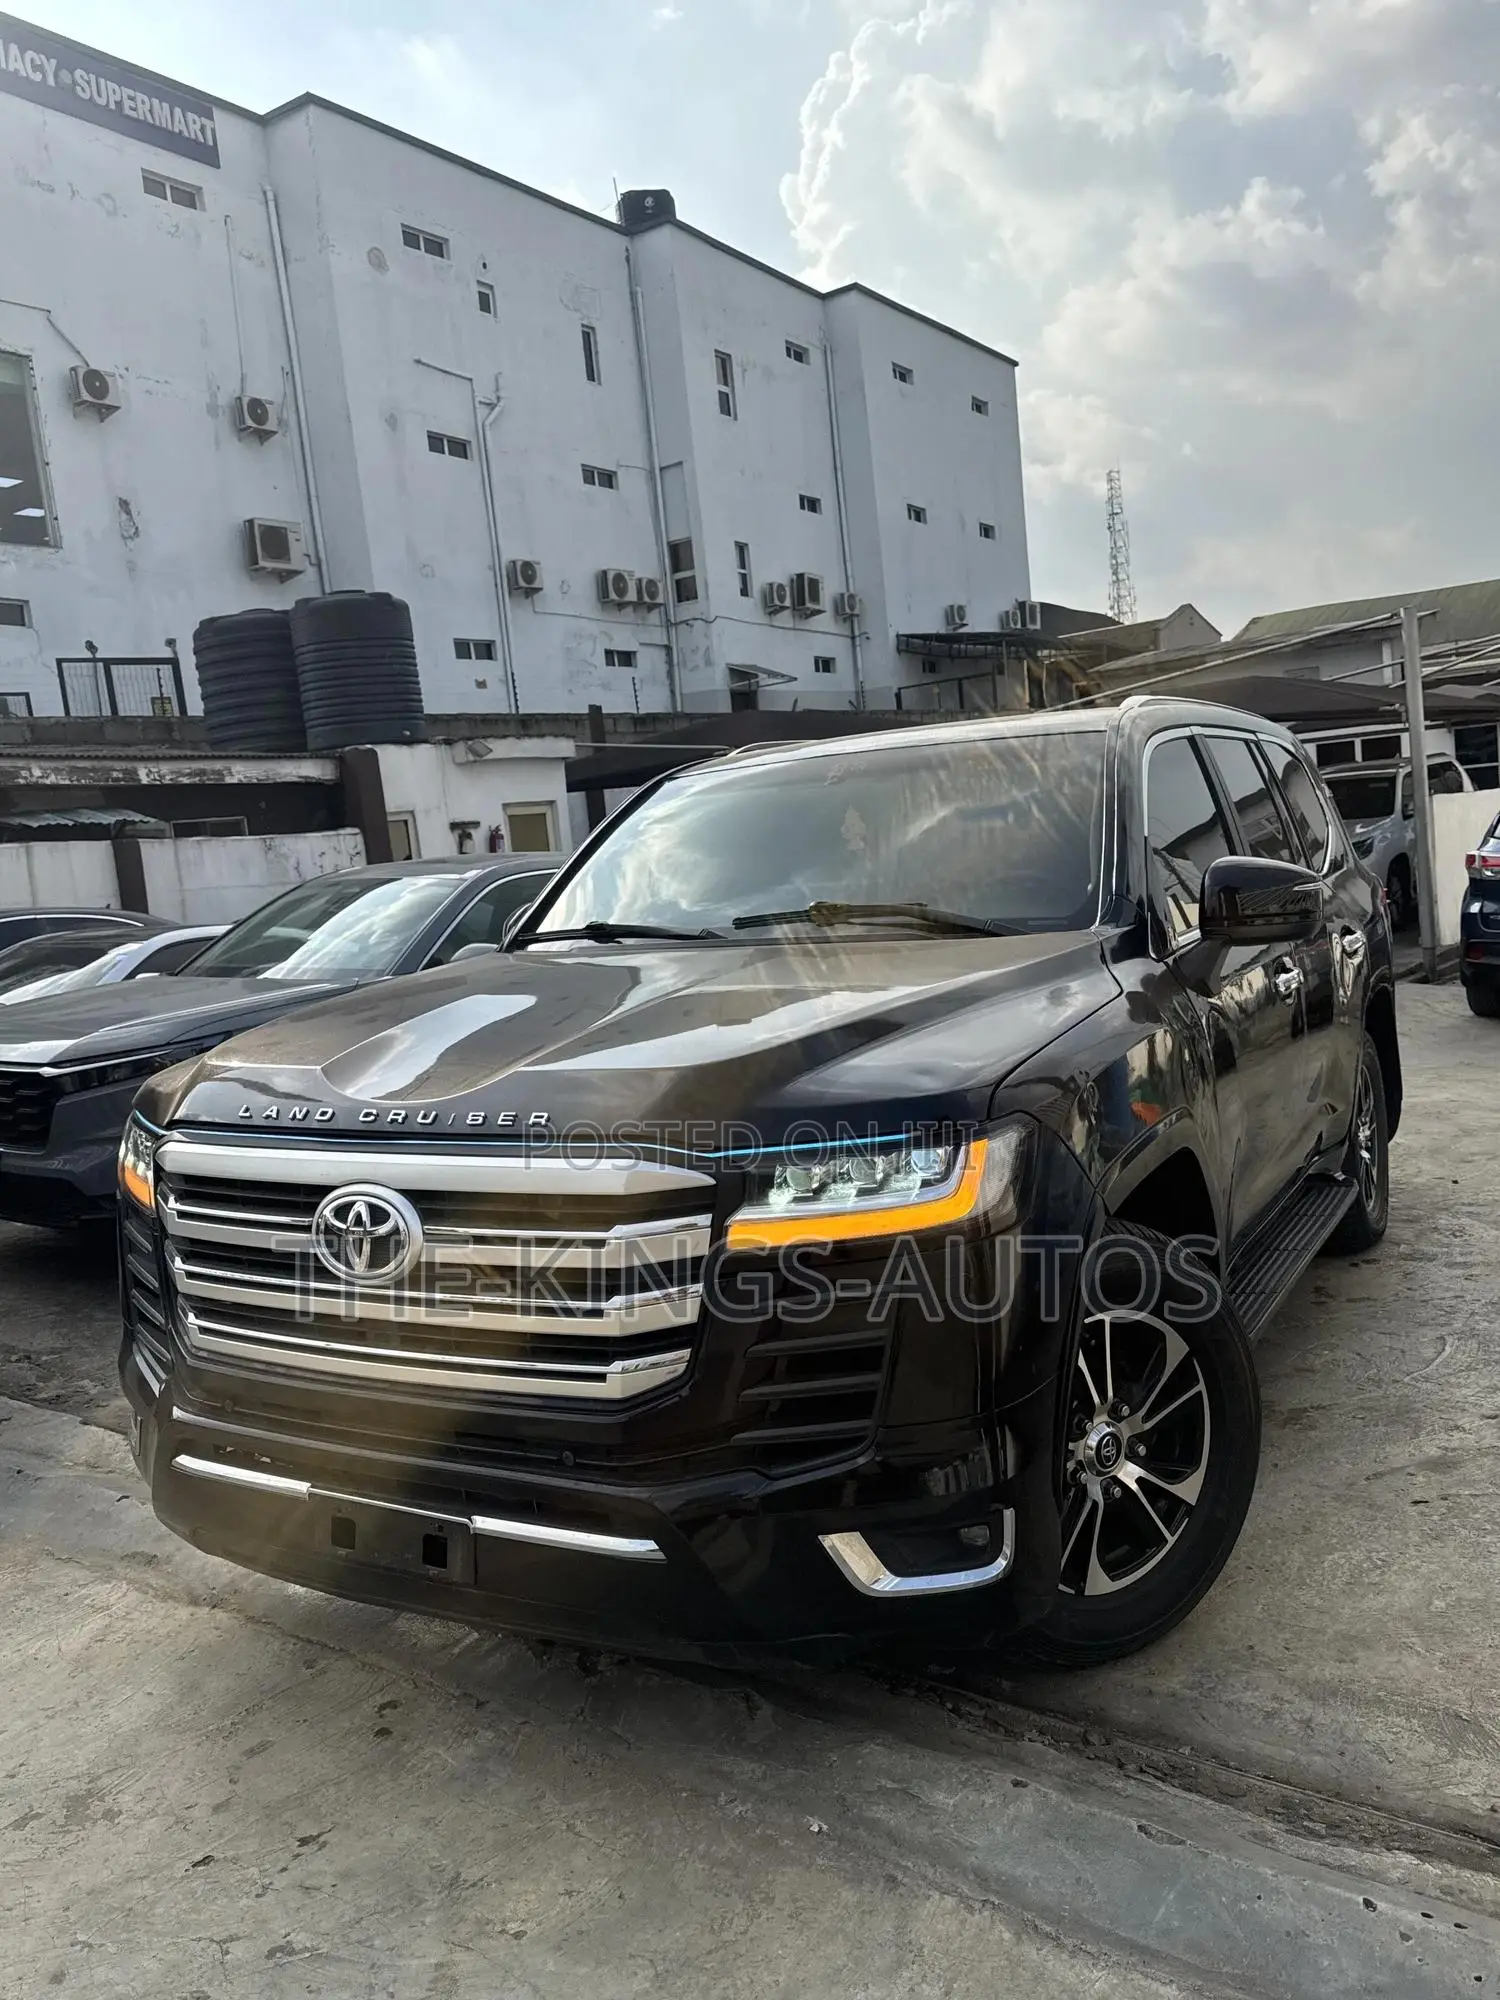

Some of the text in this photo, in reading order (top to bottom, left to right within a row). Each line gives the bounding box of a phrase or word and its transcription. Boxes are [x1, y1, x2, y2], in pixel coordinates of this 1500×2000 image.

[73, 68, 216, 147] SUPERMART
[238, 1104, 551, 1127] LAND CRUISER
